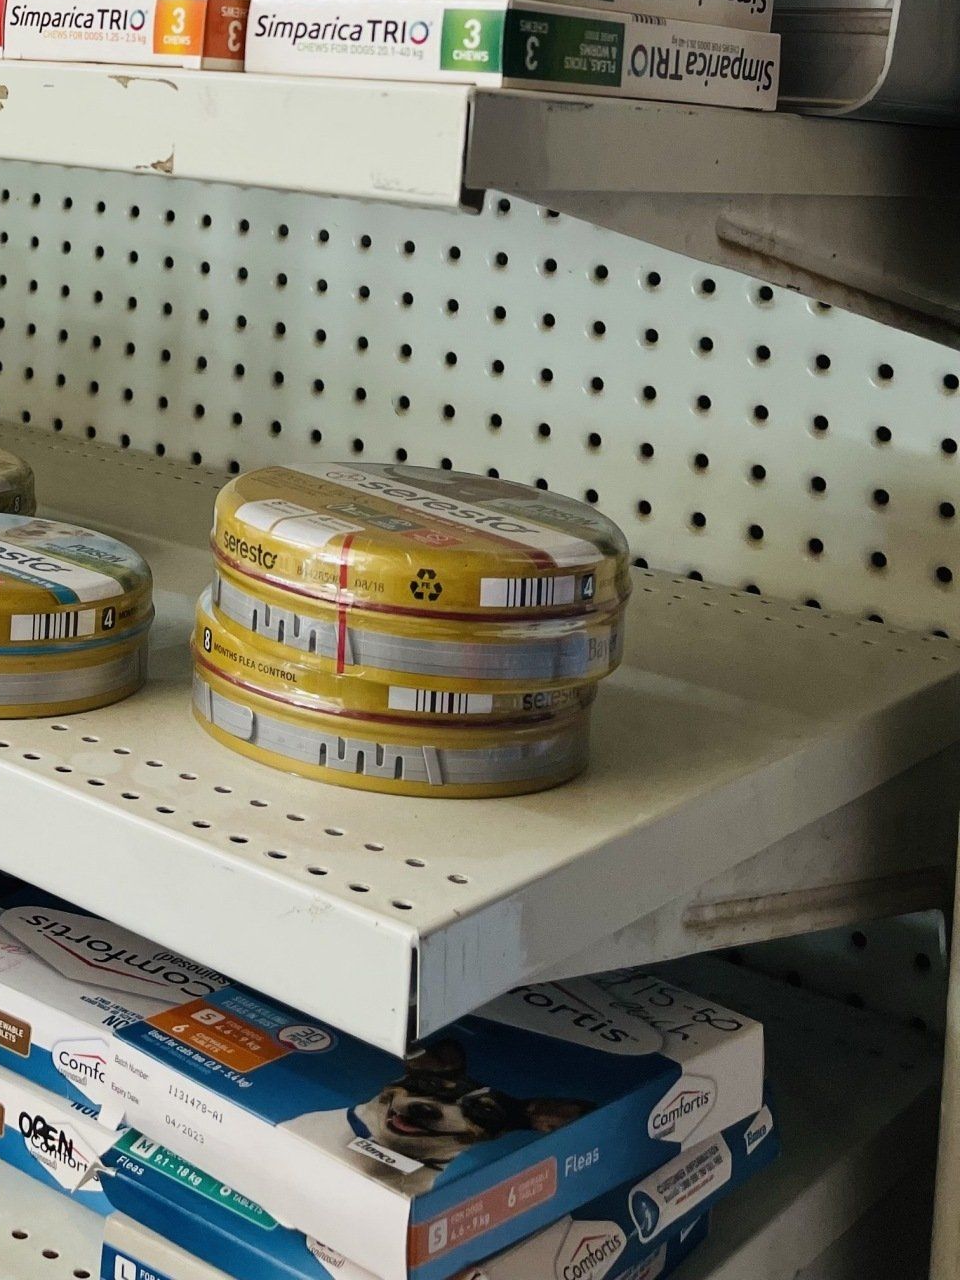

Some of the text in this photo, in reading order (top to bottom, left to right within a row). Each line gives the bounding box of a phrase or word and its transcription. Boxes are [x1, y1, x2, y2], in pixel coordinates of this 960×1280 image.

[255, 15, 429, 45] Simparica TRIO
[463, 19, 481, 48] 3
[359, 479, 539, 535] seresto
[223, 530, 278, 570] seresto
[213, 643, 297, 682] MONTHS FLEA CONTROL
[18, 1111, 74, 1158] OPEN
[116, 1155, 145, 1175] Fleas
[354, 1139, 397, 1167] Elanco
[564, 1147, 600, 1177] Fleas
